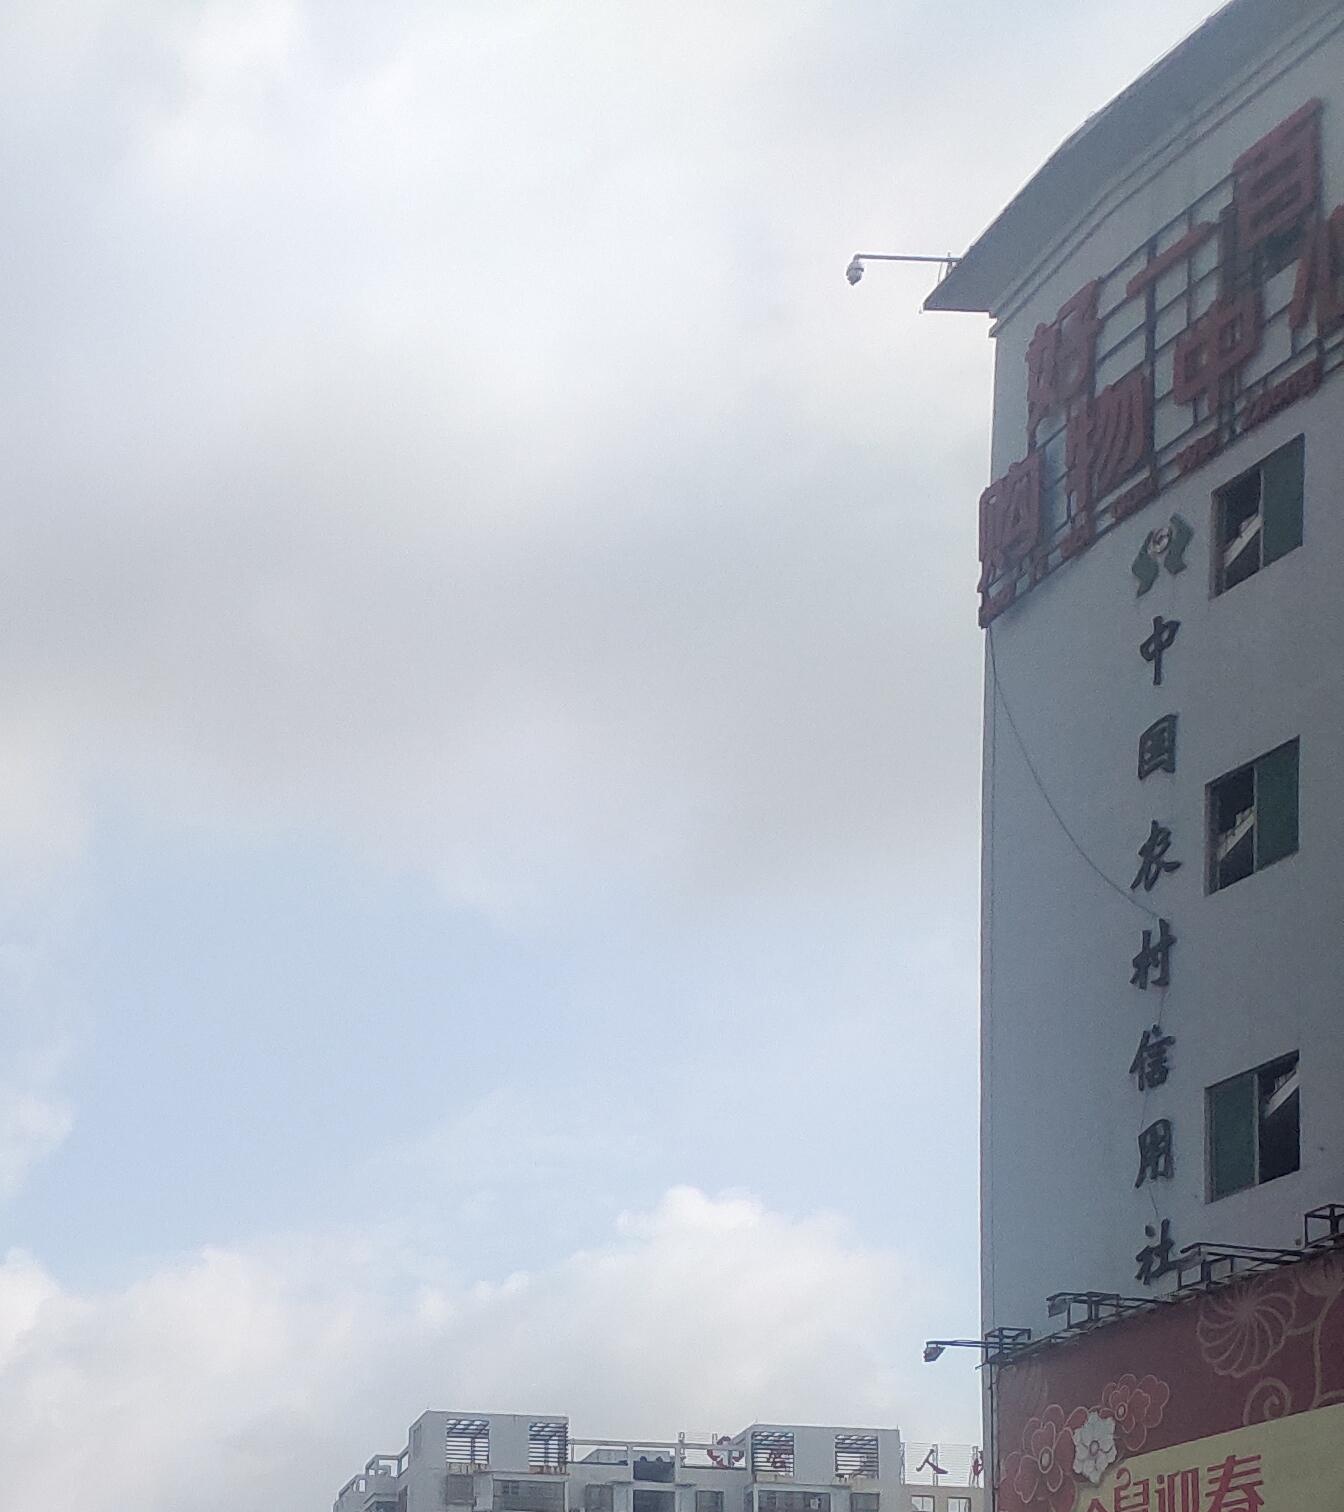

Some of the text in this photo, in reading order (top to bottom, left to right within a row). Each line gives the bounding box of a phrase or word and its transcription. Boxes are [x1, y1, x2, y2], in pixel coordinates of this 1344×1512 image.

[1130, 613, 1182, 1287] 中国农村信用社
